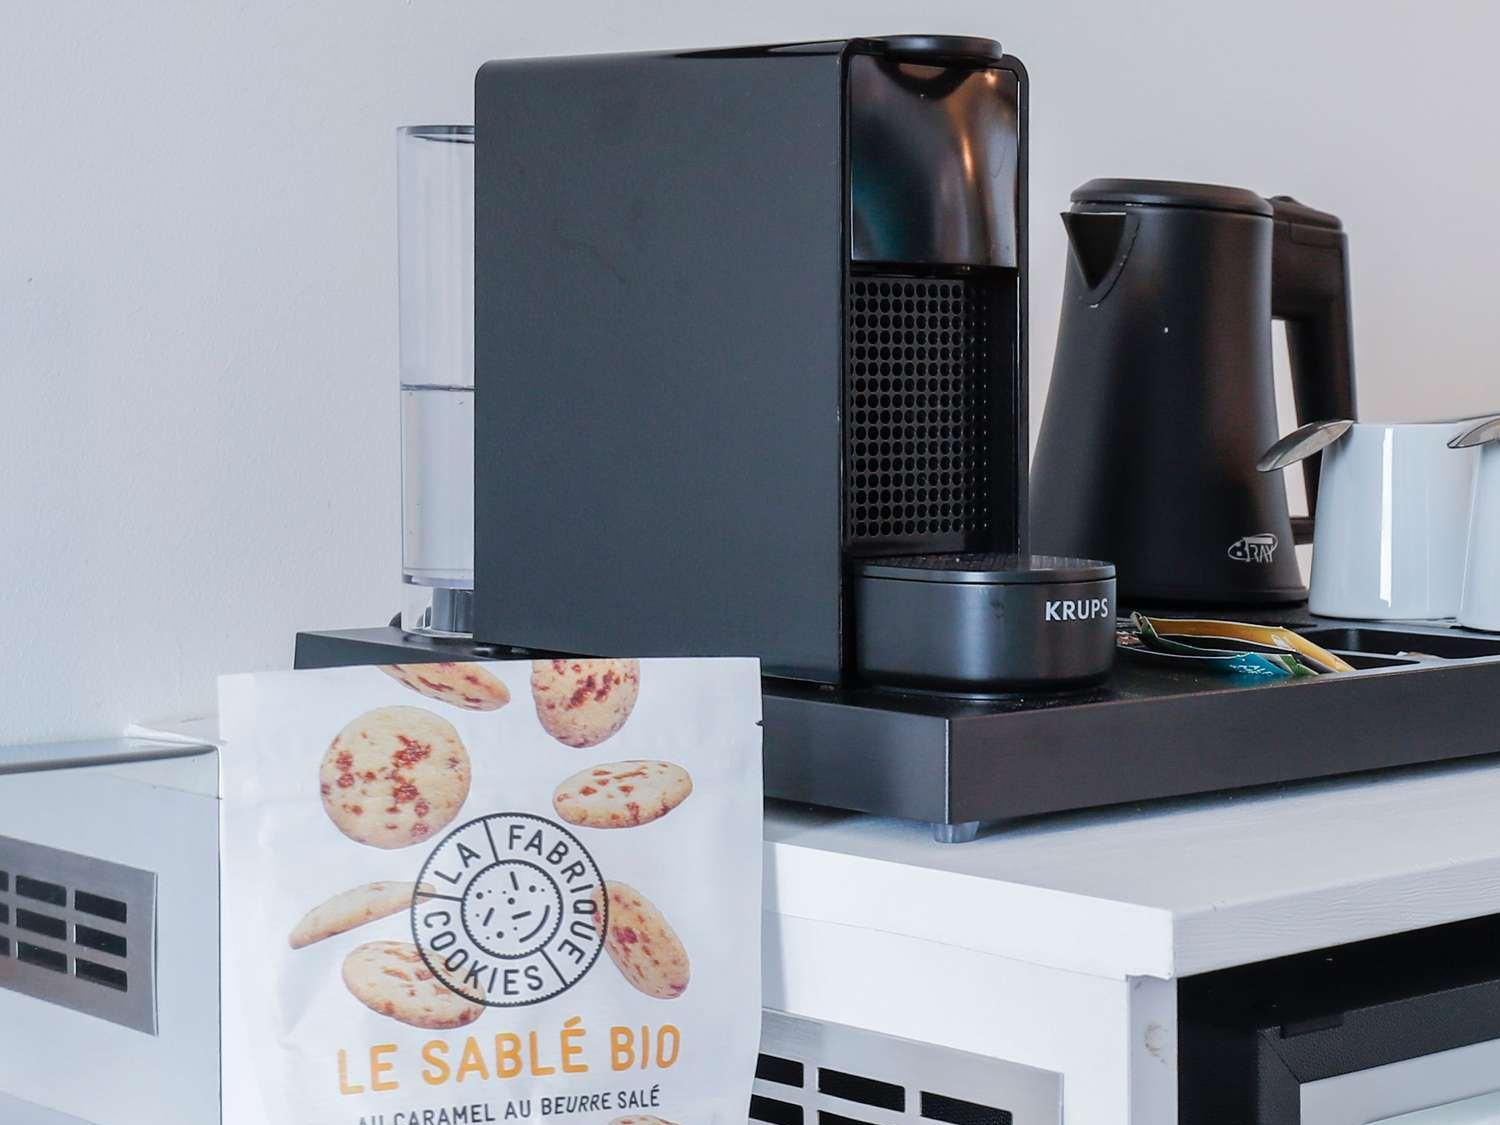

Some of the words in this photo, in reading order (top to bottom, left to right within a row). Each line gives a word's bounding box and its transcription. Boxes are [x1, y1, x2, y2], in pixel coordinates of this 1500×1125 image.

[1045, 597, 1109, 621] KRUPS
[433, 842, 481, 885] LA
[508, 825, 597, 965] FABRIQUE
[423, 910, 544, 995] COOKIES
[337, 1043, 399, 1096] LE
[421, 1016, 590, 1085] SABLÉ
[609, 1024, 681, 1072] BIO
[504, 1099, 532, 1120] AU
[541, 1092, 613, 1115] BEURRE
[617, 1085, 661, 1109] SALÉ
